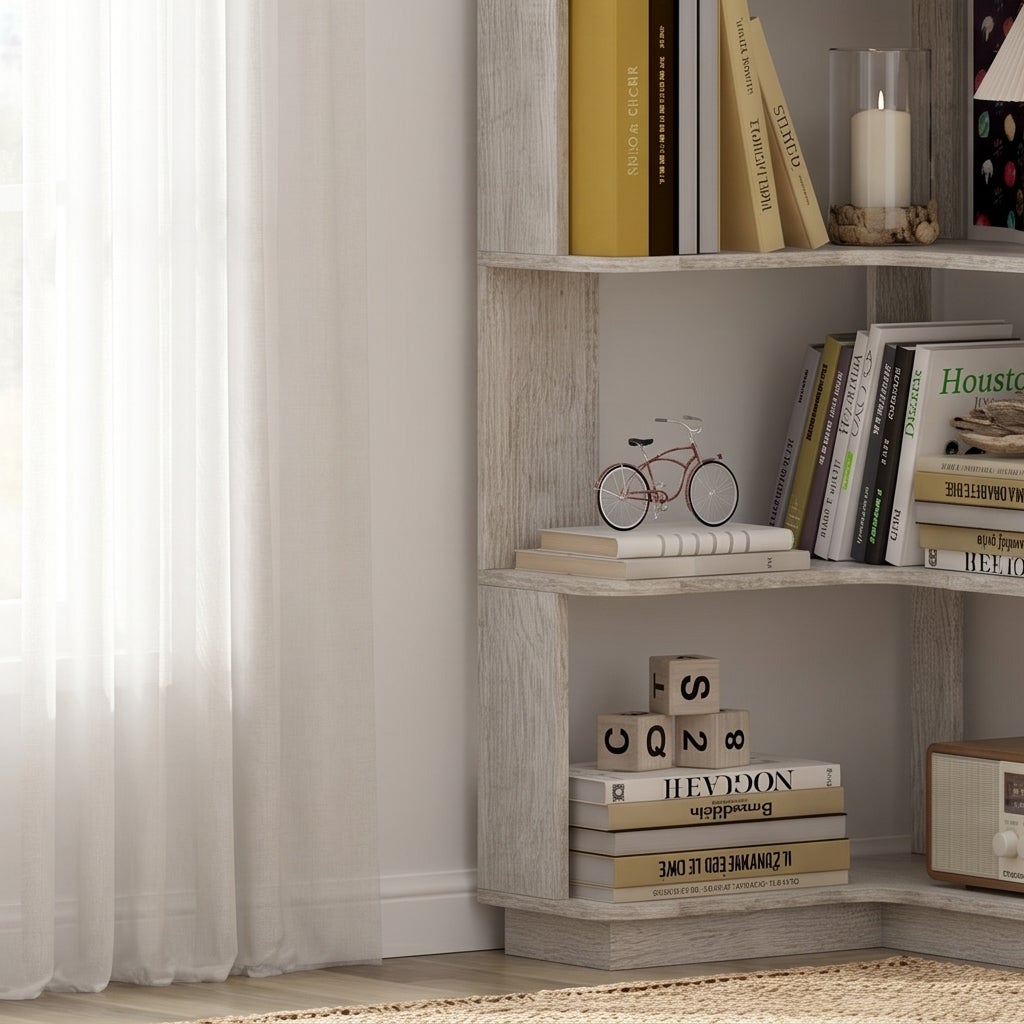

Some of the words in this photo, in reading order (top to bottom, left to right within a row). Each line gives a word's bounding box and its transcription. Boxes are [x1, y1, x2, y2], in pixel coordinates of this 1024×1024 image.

[653, 672, 665, 699] T
[680, 674, 711, 702] S
[604, 727, 630, 755] C
[646, 724, 667, 758] Q
[683, 729, 708, 752] 2
[724, 728, 746, 750] 8
